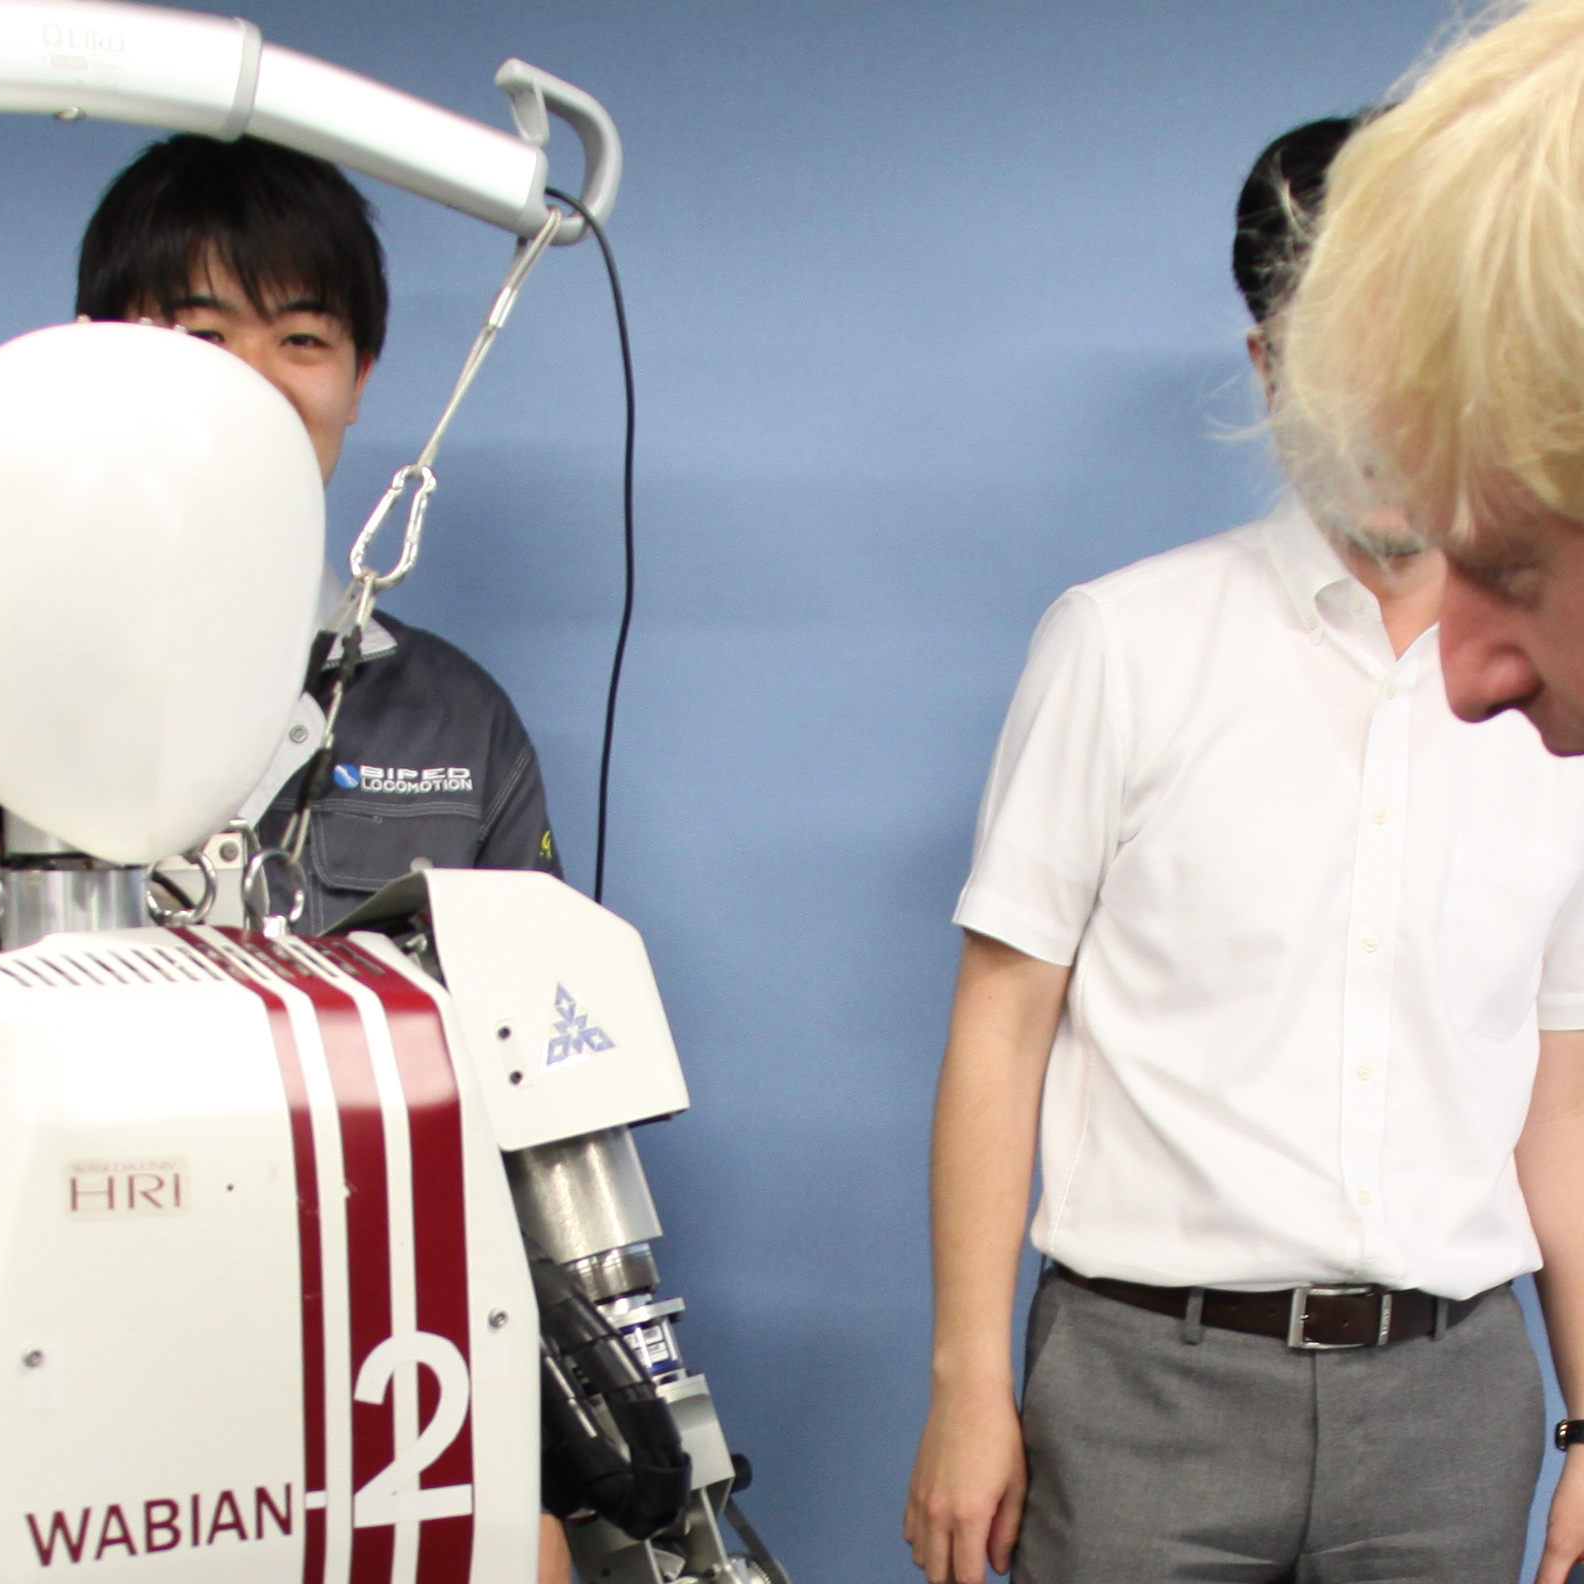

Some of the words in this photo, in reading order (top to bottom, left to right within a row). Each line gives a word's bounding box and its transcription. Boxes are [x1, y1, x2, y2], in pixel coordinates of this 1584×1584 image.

[360, 765, 471, 780] BIPED
[361, 778, 473, 794] LOCOMOTION
[71, 1173, 180, 1211] HRI
